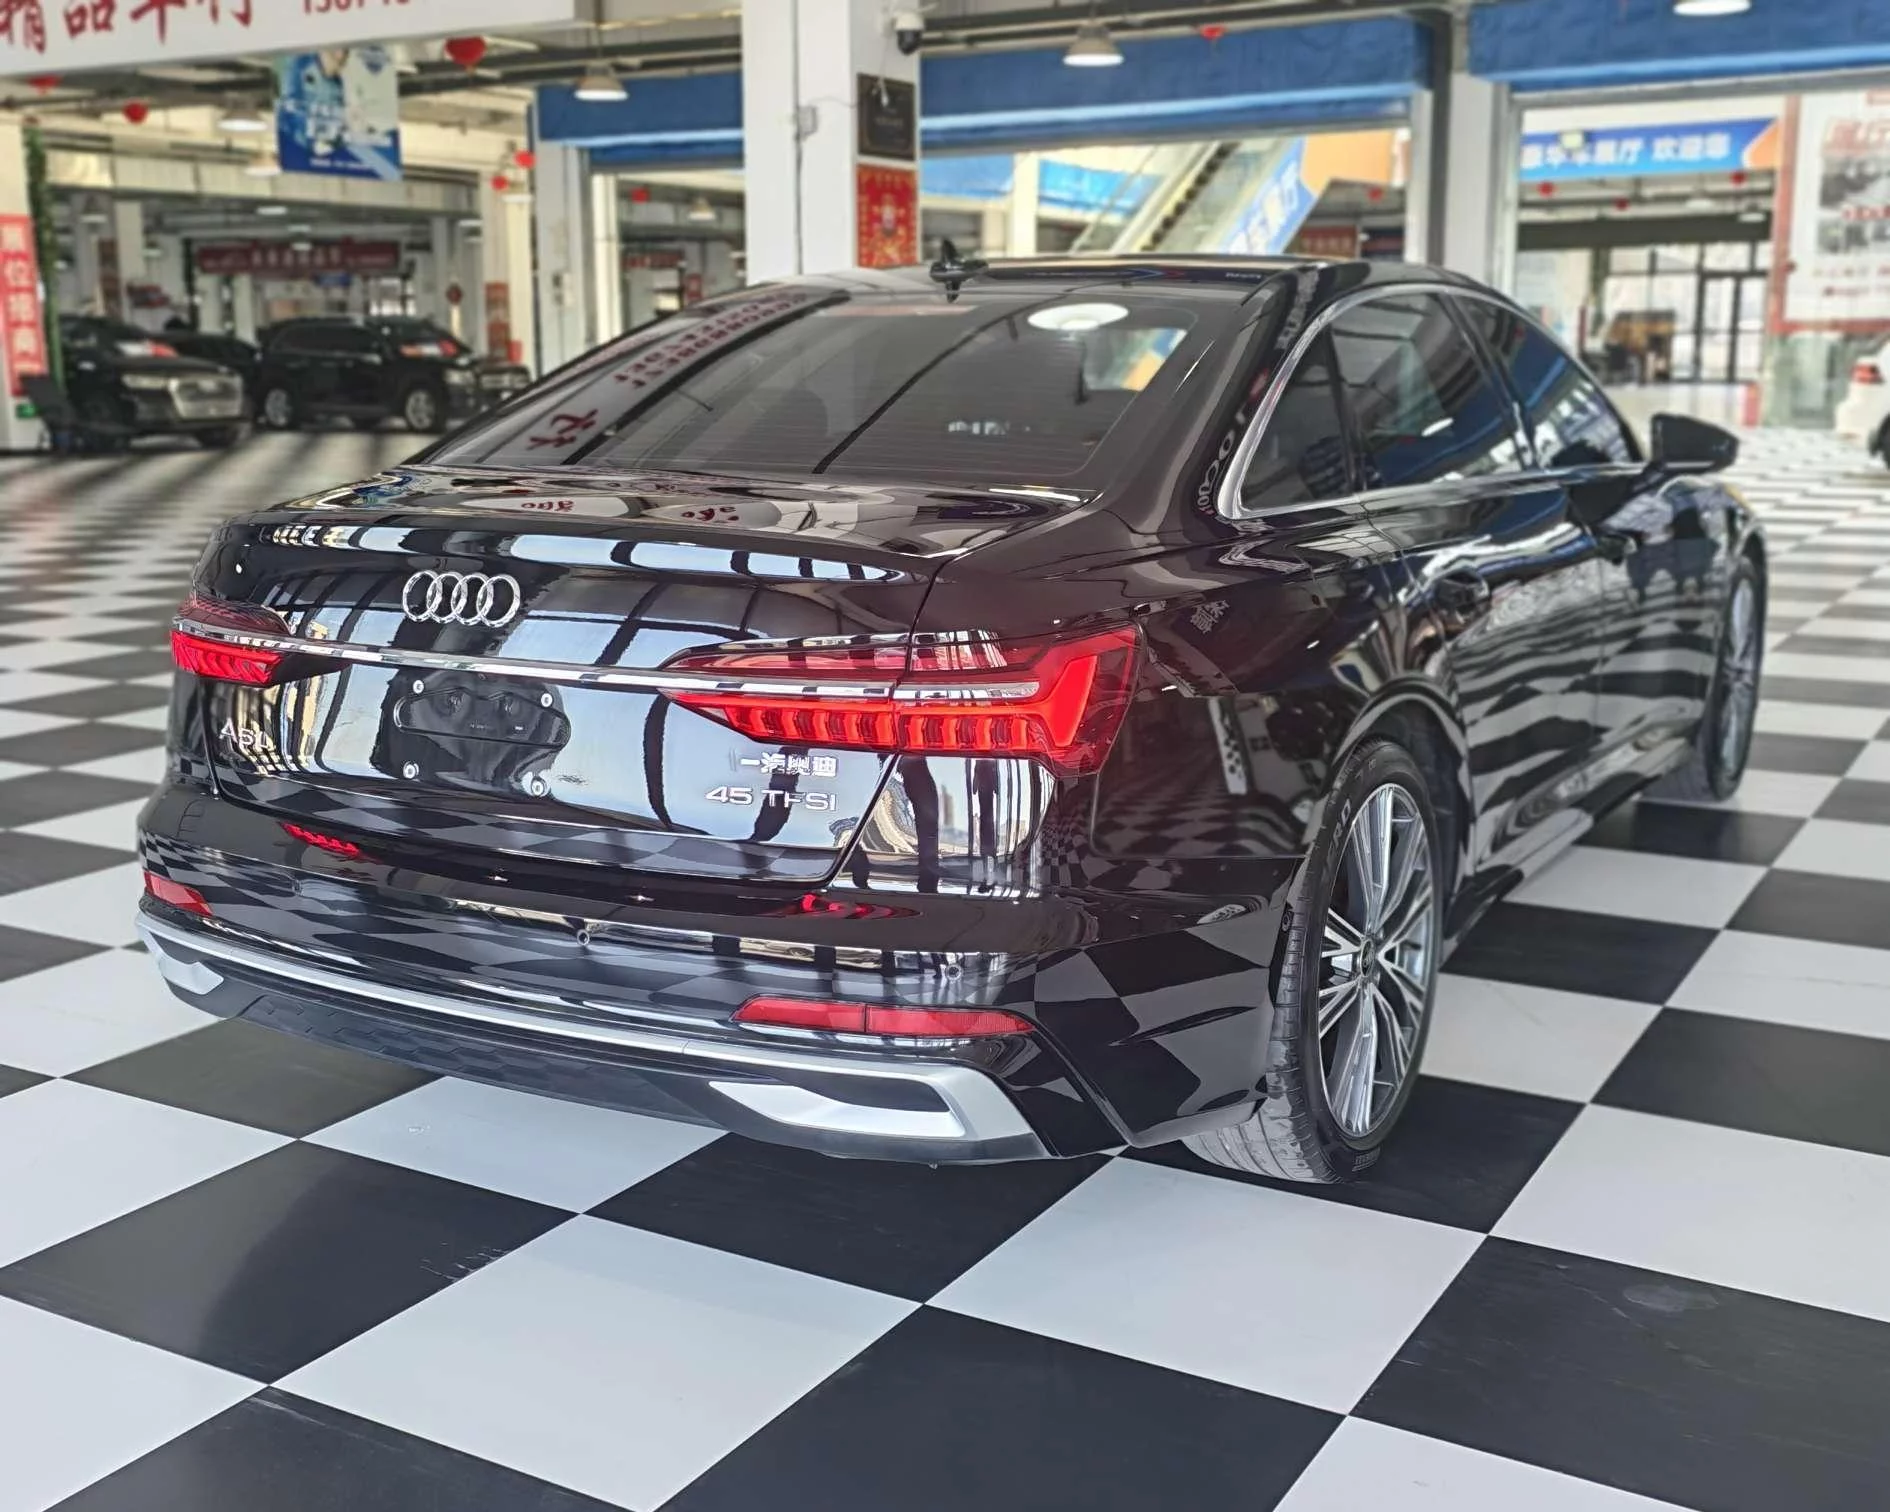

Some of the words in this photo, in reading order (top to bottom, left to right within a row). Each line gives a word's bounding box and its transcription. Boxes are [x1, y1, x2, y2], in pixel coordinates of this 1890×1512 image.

[218, 717, 277, 753] A6L
[740, 751, 838, 778] 一汽奥迪
[704, 785, 753, 806] 45
[760, 788, 838, 812] TFSI
